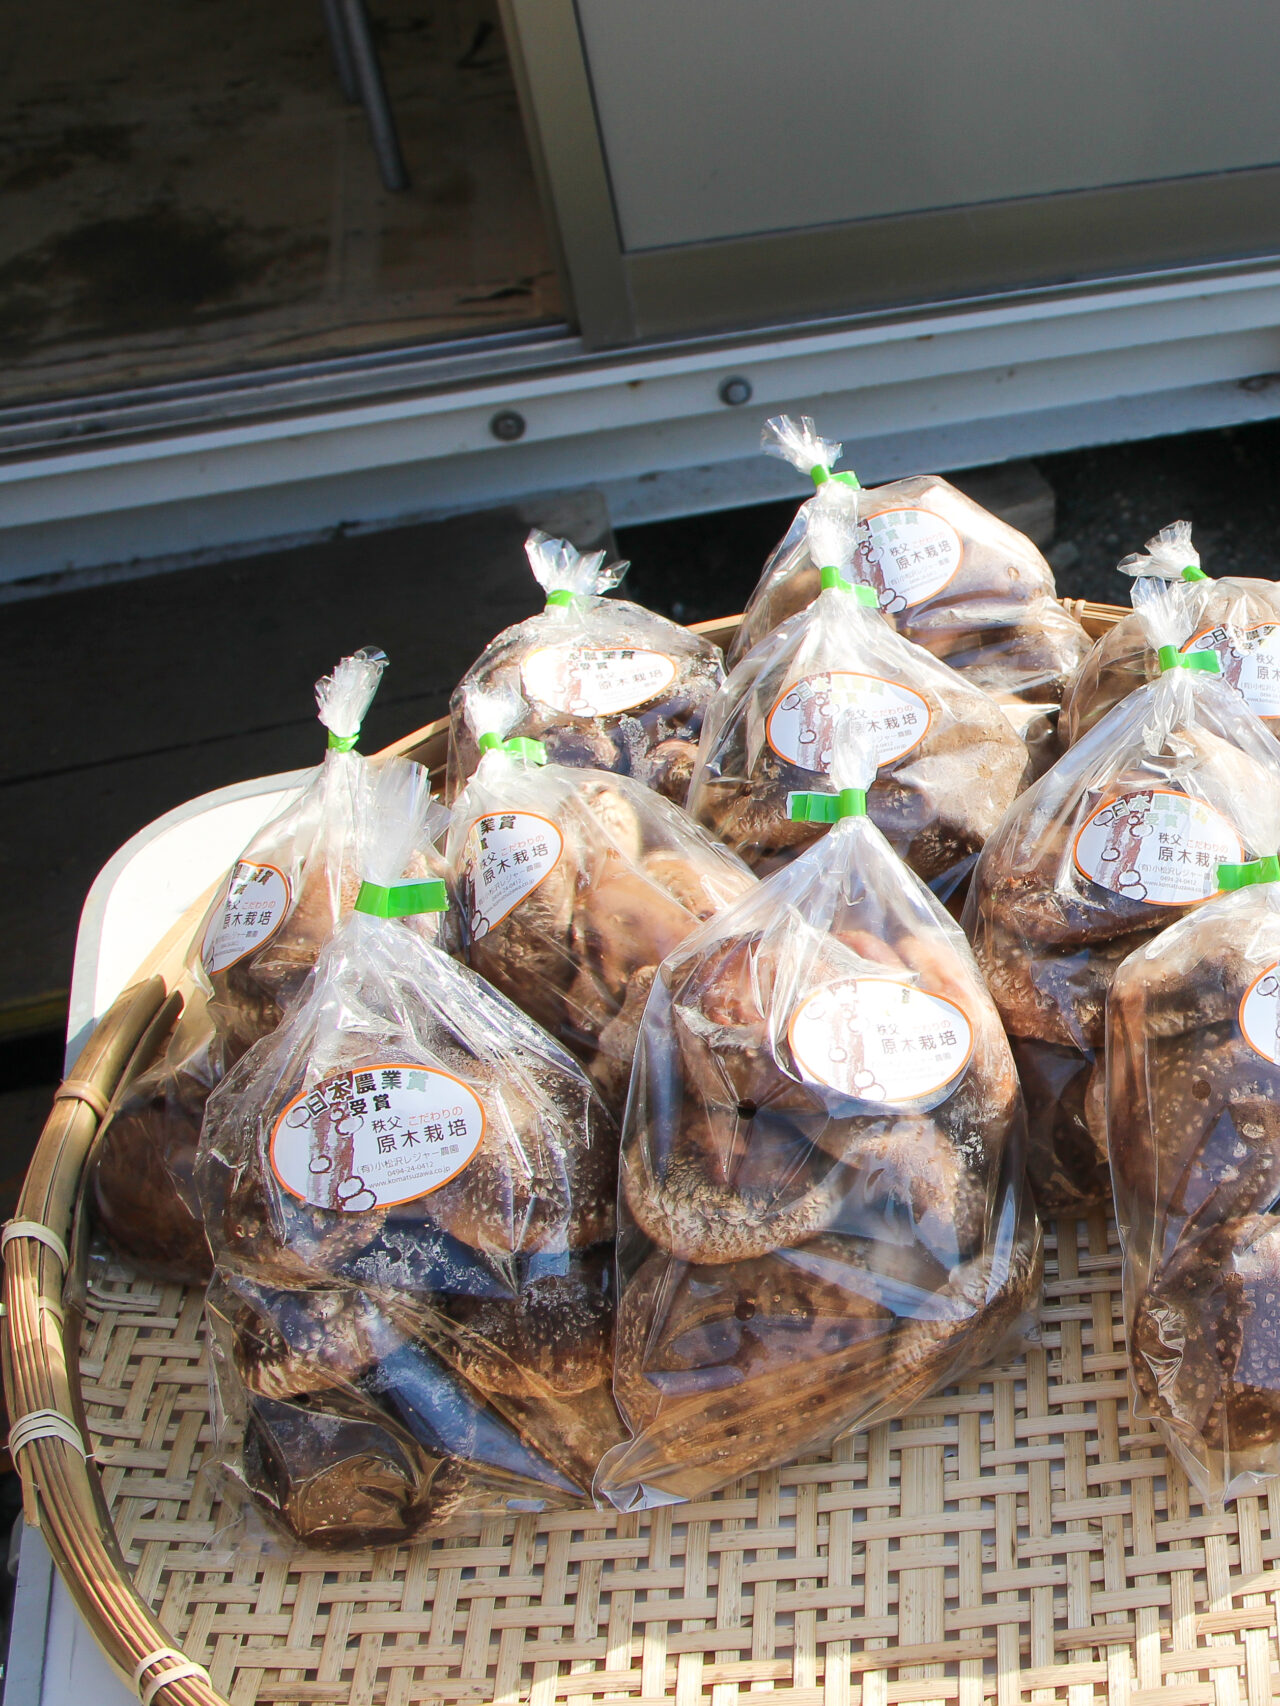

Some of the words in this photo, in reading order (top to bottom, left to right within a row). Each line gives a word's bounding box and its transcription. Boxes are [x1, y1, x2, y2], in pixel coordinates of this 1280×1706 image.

[1159, 832, 1182, 846] 秩父
[482, 843, 549, 886] 原木栽培
[881, 1031, 957, 1055] 原木栽培
[305, 1070, 429, 1117] 日本農業賞
[350, 1094, 391, 1116] 受賞
[371, 1115, 403, 1133] 秩父
[408, 1106, 463, 1126] こだわりの
[377, 1119, 467, 1154] 原木栽培
[368, 1166, 451, 1189] www.komatsuzawa.co.jp
[387, 1161, 434, 1176] 0494-24-0412
